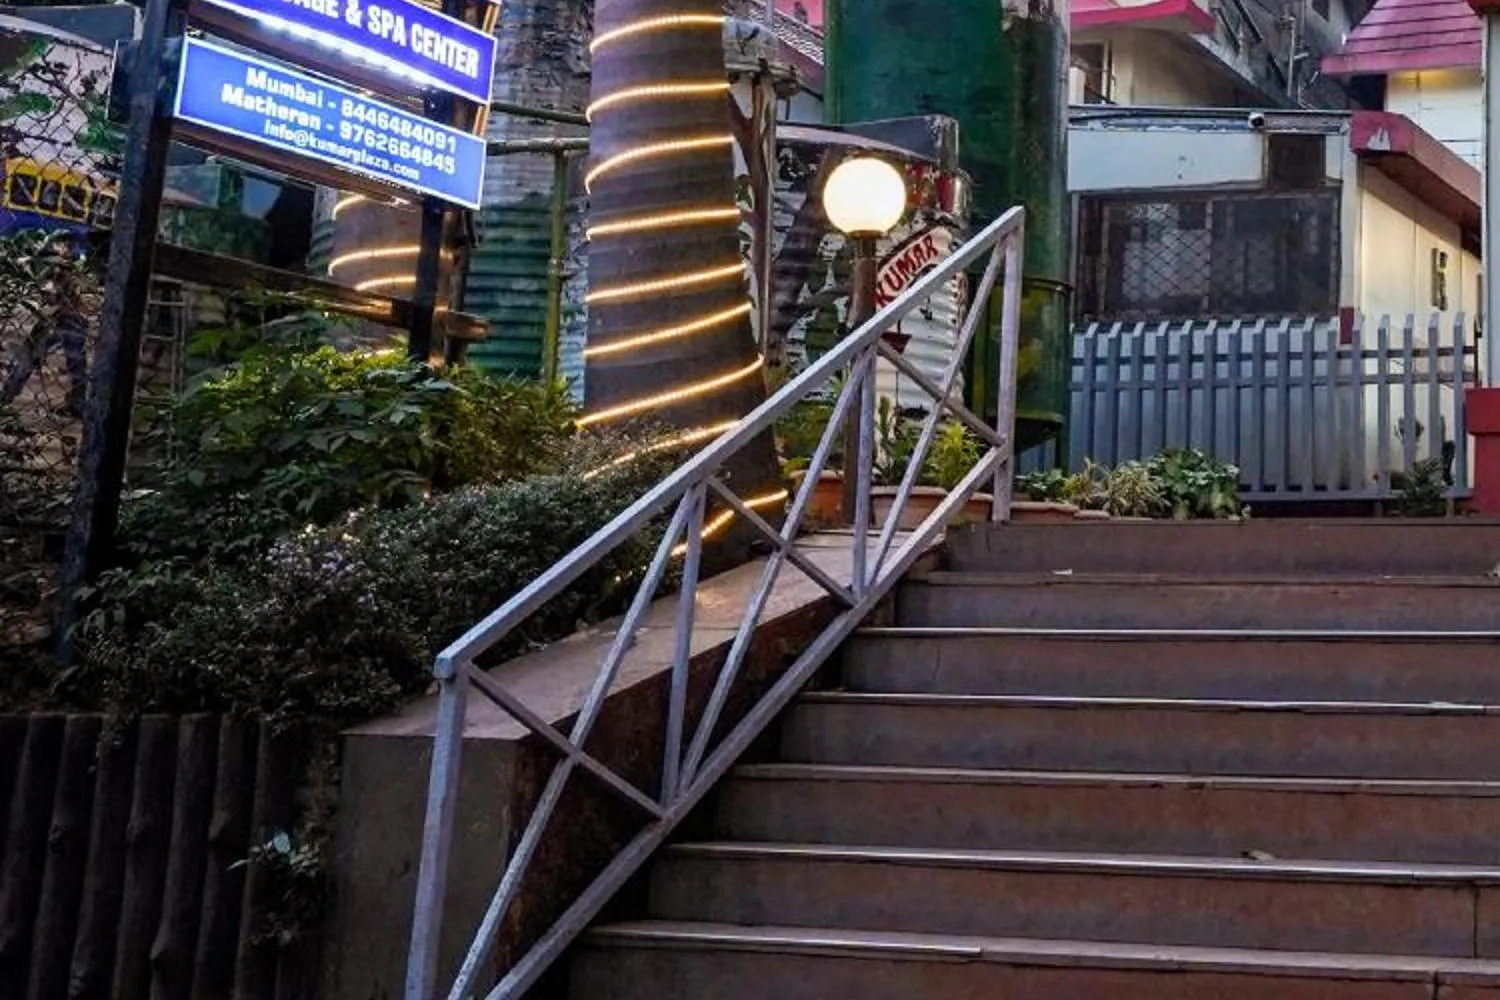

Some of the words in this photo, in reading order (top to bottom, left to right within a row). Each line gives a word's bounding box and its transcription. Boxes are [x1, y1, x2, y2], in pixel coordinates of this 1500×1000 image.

[366, 2, 406, 46] SPA
[410, 25, 480, 80] CENTER
[221, 83, 321, 131] Matheran
[339, 120, 456, 175] 9762664845
[245, 67, 324, 109] Mumbai
[340, 98, 457, 154] 8446484091
[875, 234, 939, 308] KUMAR
